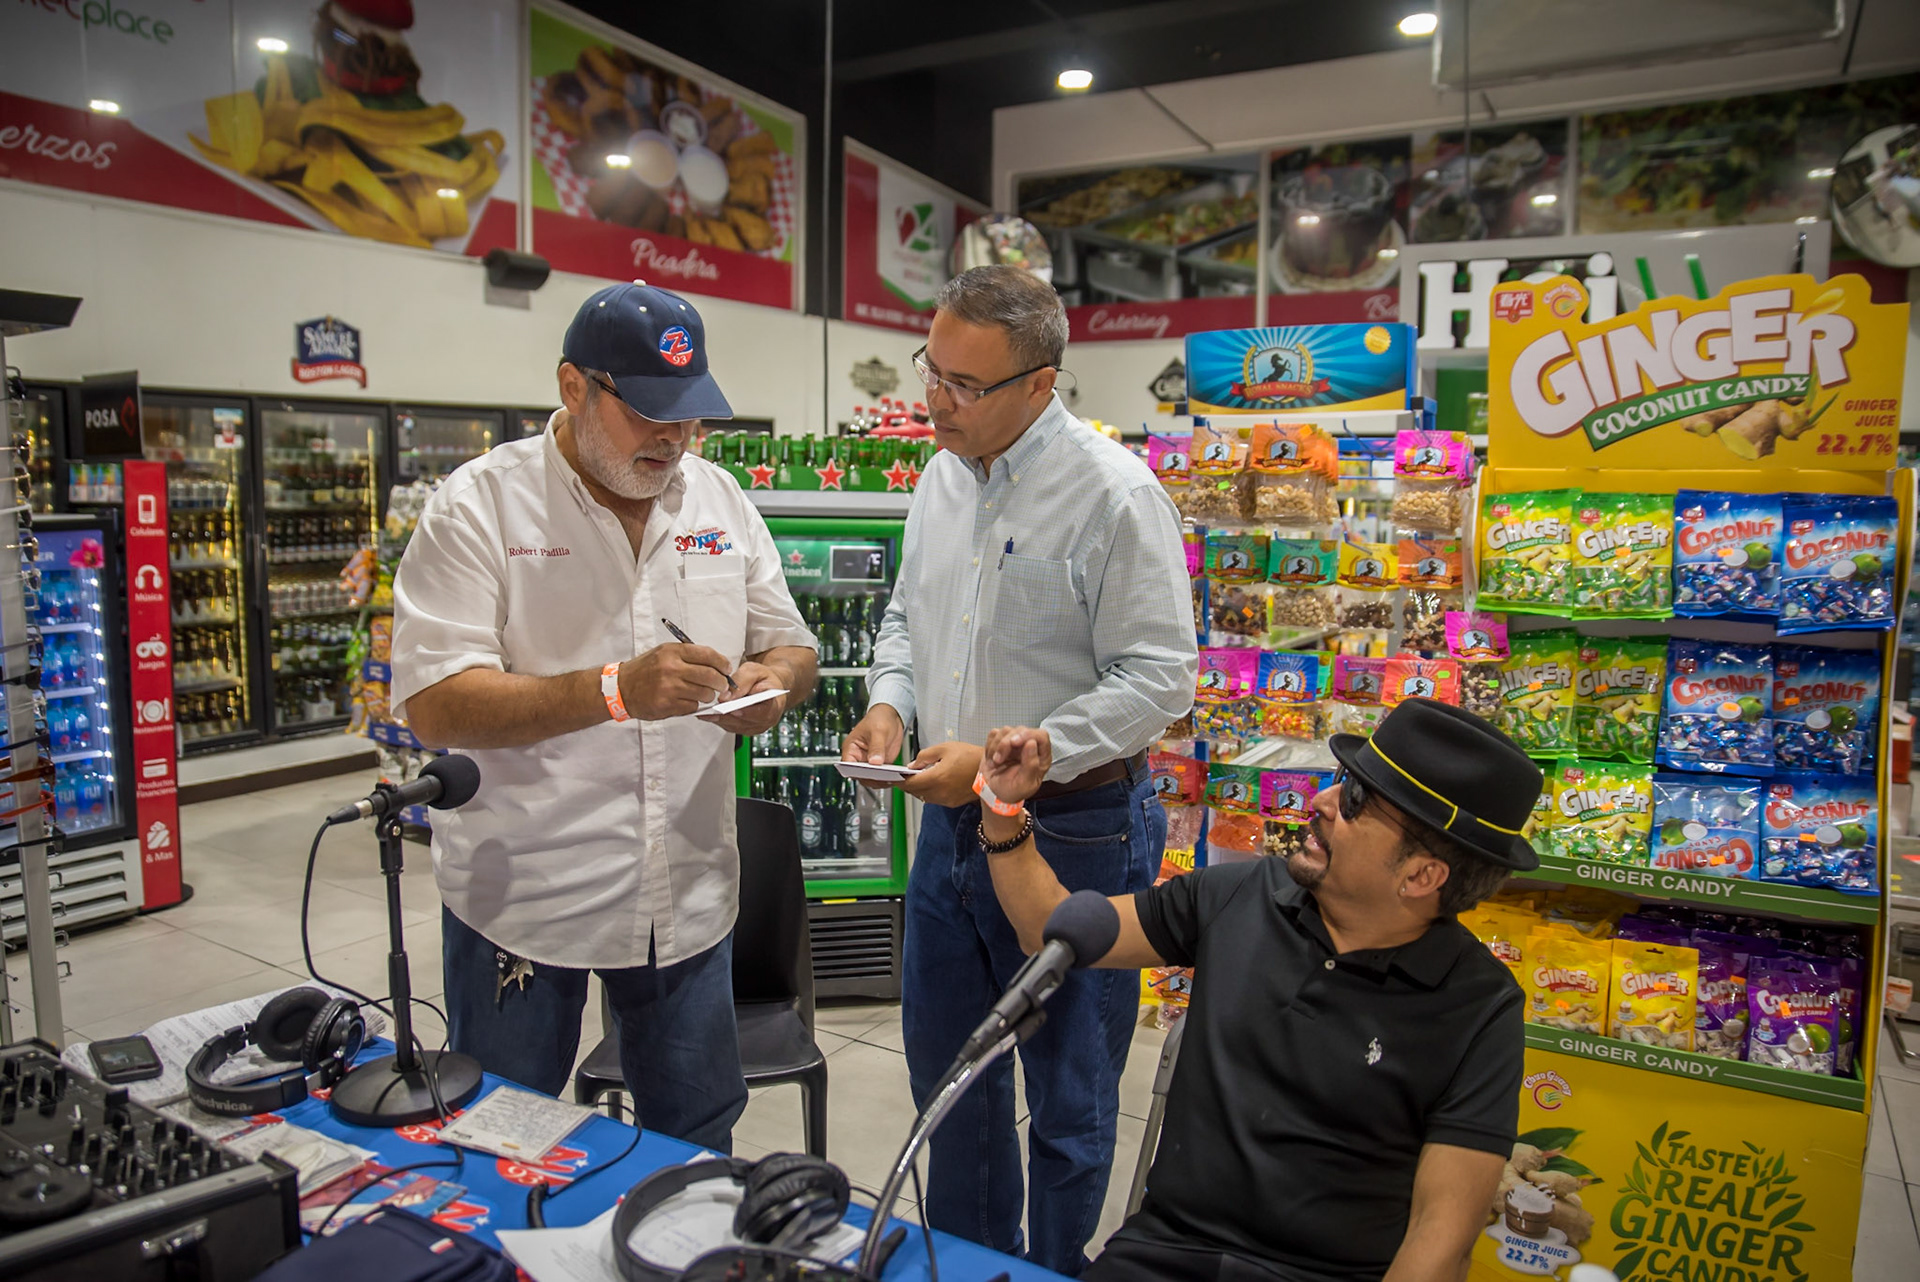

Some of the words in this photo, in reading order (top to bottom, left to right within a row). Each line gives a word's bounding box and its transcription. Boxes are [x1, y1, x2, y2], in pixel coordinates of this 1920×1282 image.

[1088, 309, 1170, 338] Catering
[666, 330, 688, 354] Z
[672, 355, 688, 365] 93
[1510, 288, 1857, 438] GINGER
[84, 408, 120, 428] POSA
[1591, 386, 1712, 441] COCONUT
[1715, 376, 1811, 406] CANDY
[1843, 398, 1898, 412] GINGER
[1855, 413, 1896, 428] JUICE
[1815, 433, 1895, 456] 22.7%
[674, 535, 696, 551] 30
[1486, 518, 1571, 550] GINGER
[1576, 521, 1670, 558] GINGER
[1678, 520, 1775, 556] COCONUT
[508, 546, 537, 557] Robert
[540, 547, 571, 557] Padilla
[1785, 532, 1889, 571] COCONUT
[137, 659, 167, 671] Juegos
[1577, 666, 1660, 697] GINGER
[1672, 674, 1767, 706] COCONUT
[1773, 681, 1868, 712] COCONUT
[1558, 786, 1650, 818] GINGER
[1764, 802, 1870, 830] COCONUT
[155, 851, 174, 861] Mas
[1576, 864, 1655, 888] GINGER
[1660, 874, 1736, 898] CANDY
[1533, 966, 1599, 993] GINGER
[1620, 971, 1690, 997] GINGER
[1559, 1037, 1639, 1063] GINGER
[1643, 1051, 1719, 1078] CANDY
[1667, 1141, 1752, 1177] TASTE
[507, 1164, 545, 1184] 93
[1653, 1169, 1765, 1222] REAL
[1504, 1235, 1541, 1252] GINGER
[1540, 1245, 1569, 1260] JUICE
[1609, 1193, 1805, 1277] GINGER
[1504, 1247, 1550, 1270] 22.7%
